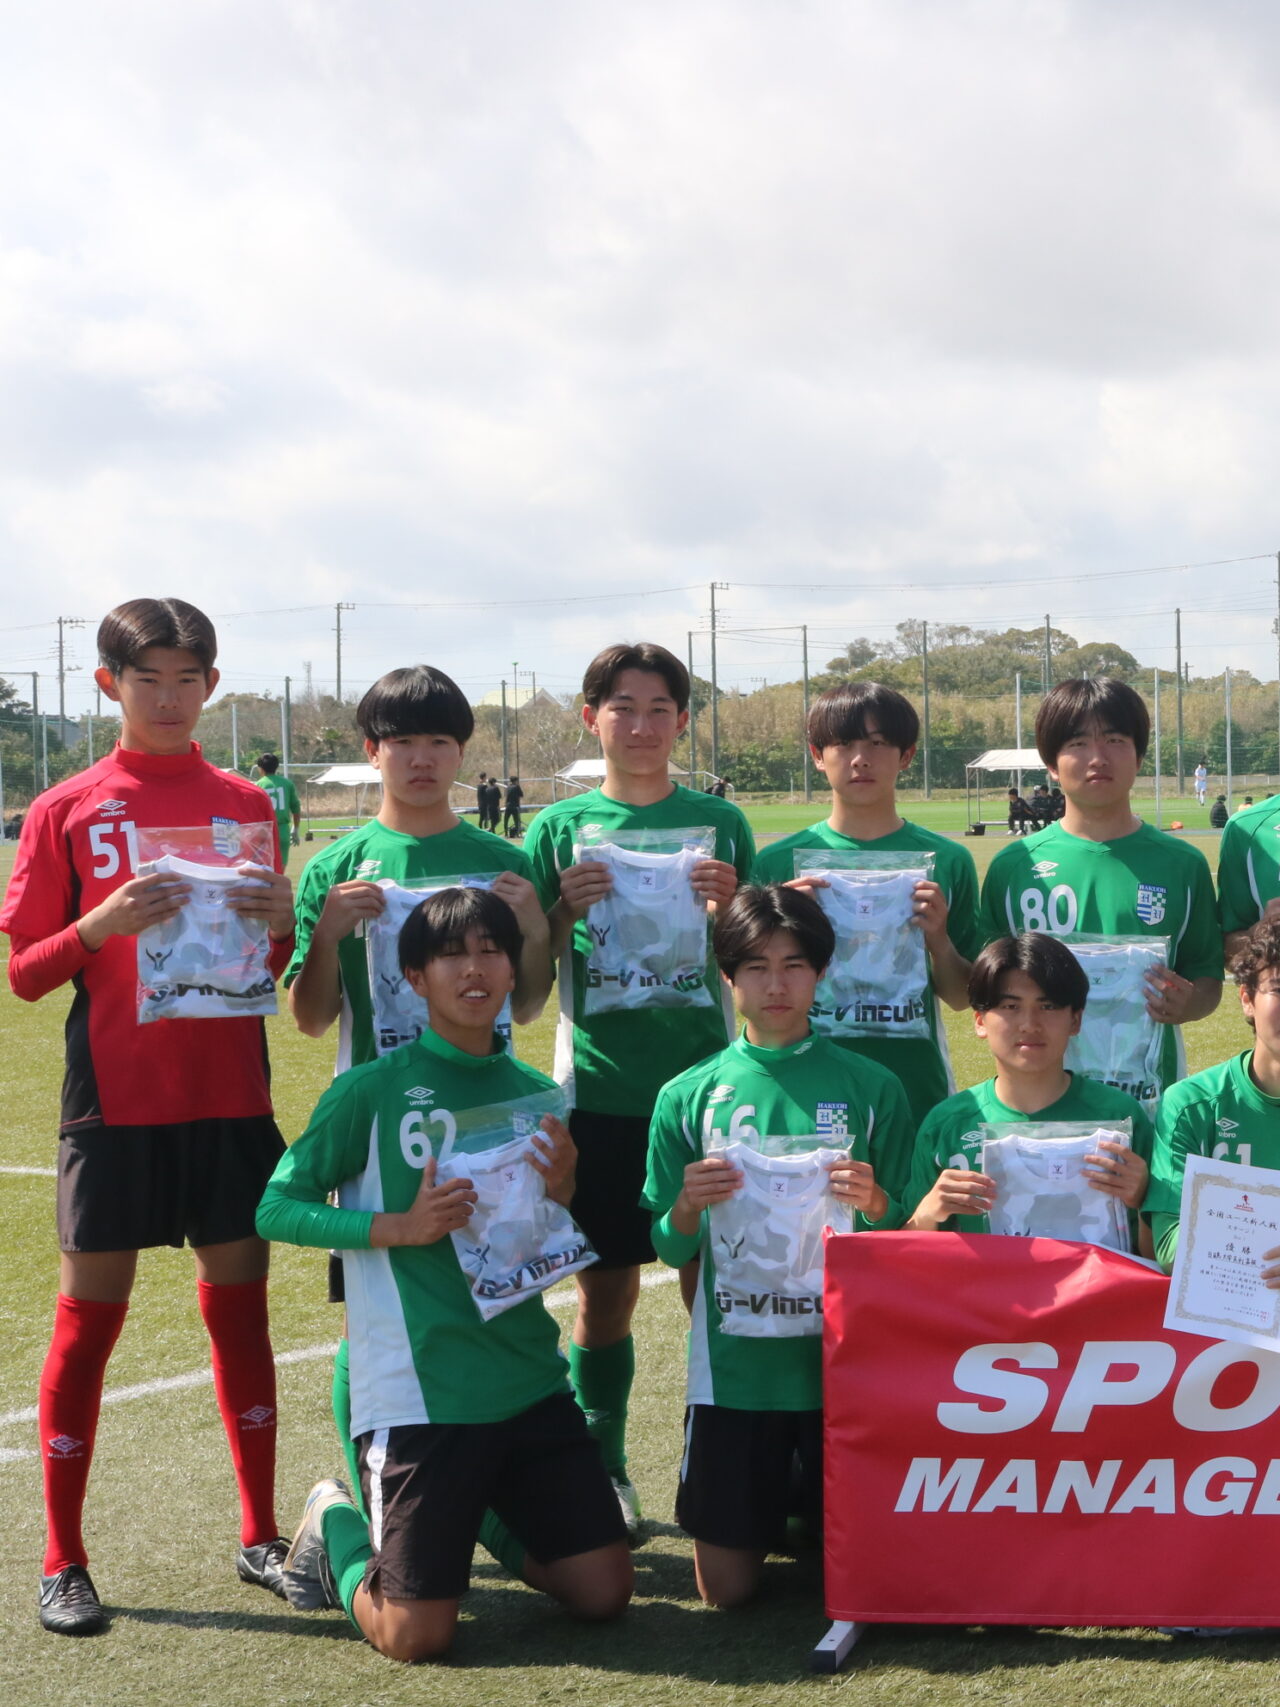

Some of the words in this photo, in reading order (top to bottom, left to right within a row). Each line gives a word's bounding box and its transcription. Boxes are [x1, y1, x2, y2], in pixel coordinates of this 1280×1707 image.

[100, 809, 126, 817] umbro
[89, 821, 139, 879] 51
[1020, 884, 1077, 936] 80
[399, 1109, 457, 1169] 62
[702, 1105, 760, 1150] 46
